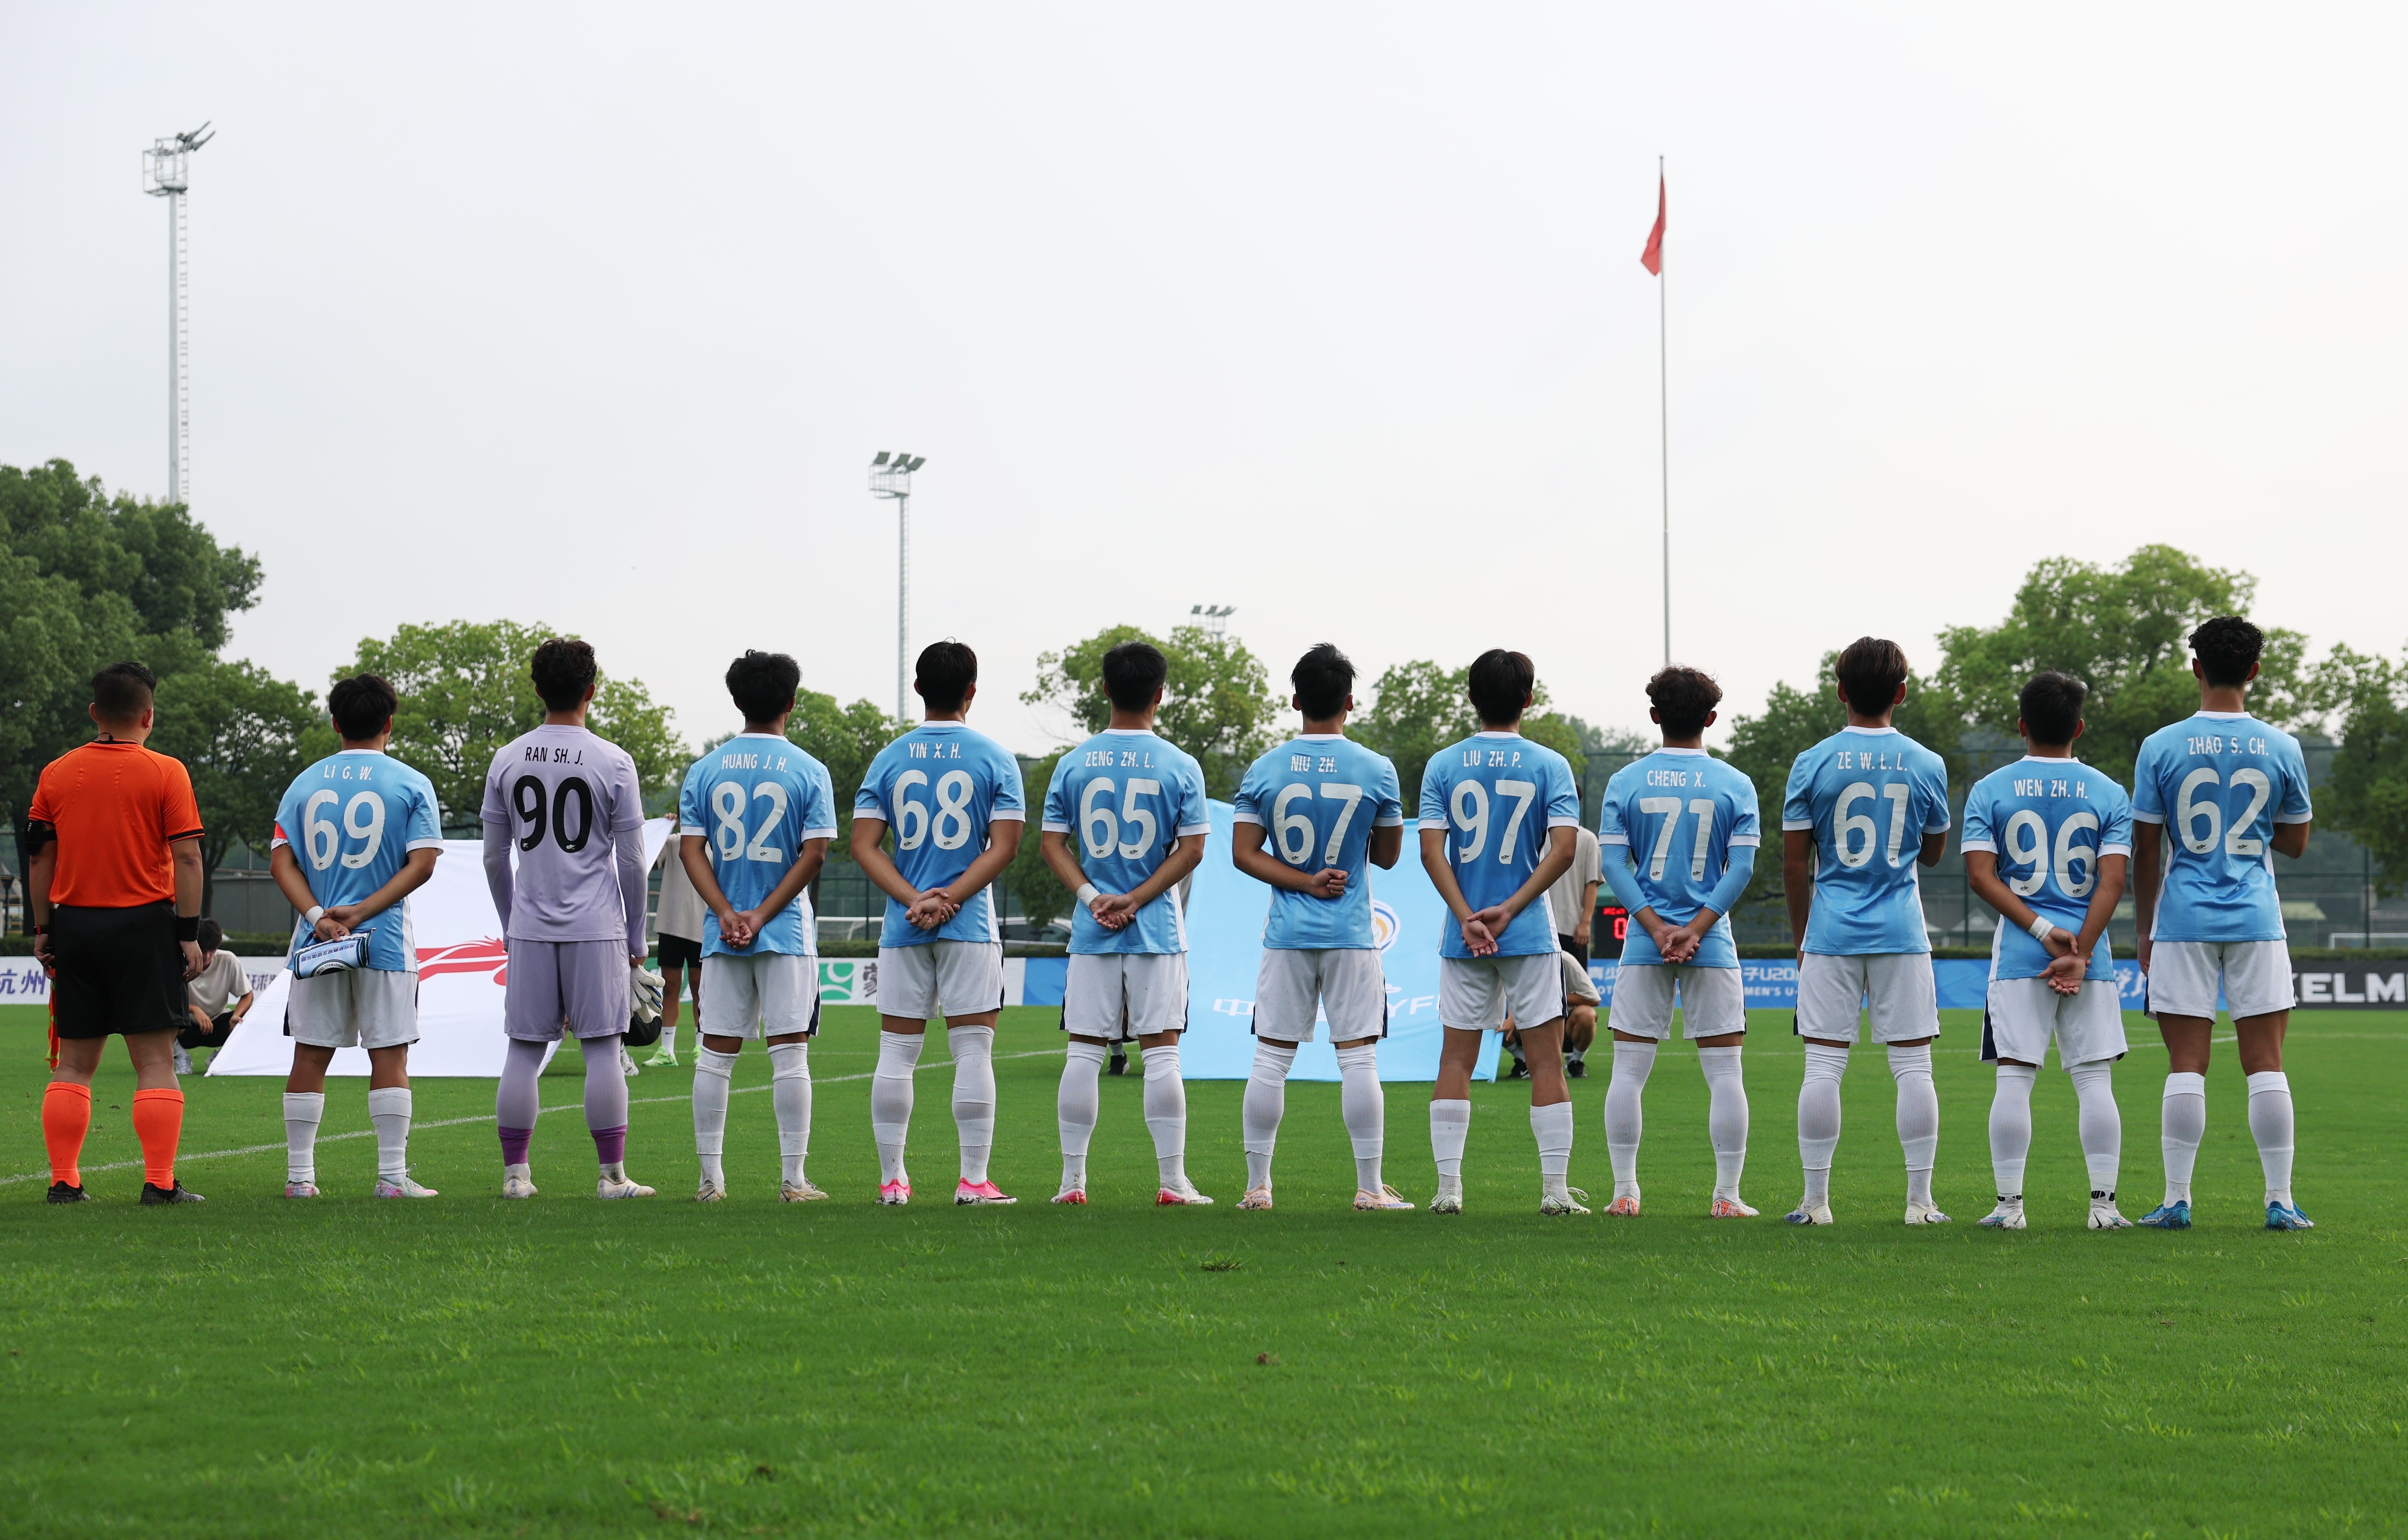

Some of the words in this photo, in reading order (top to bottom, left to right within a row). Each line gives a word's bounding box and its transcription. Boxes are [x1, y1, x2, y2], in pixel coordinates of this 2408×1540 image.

[525, 746, 548, 762] RAN
[553, 748, 570, 764] SH.
[574, 750, 583, 766] J.
[909, 743, 928, 759] YIN
[933, 743, 945, 758] X.
[950, 743, 961, 759] H.
[2187, 736, 2222, 756] ZHAO
[2231, 737, 2243, 753] S.
[2249, 737, 2269, 756] CH.
[722, 753, 758, 770] HUANG
[763, 754, 772, 770] J.
[777, 757, 787, 773] H.
[1085, 750, 1114, 767] ZENG
[1120, 751, 1139, 767] ZH.
[1144, 752, 1154, 768] L.
[1291, 755, 1310, 772] NIU
[1318, 756, 1337, 773] ZH.
[1463, 750, 1481, 767] LIU
[1488, 751, 1507, 767] ZH.
[1511, 751, 1521, 768] P.
[1838, 751, 1852, 770] ZE
[1860, 752, 1875, 770] W.
[1880, 753, 1892, 770] L.
[1896, 753, 1908, 771] L.
[324, 765, 336, 778] LI
[343, 766, 353, 779] G.
[359, 766, 373, 780] W.
[1647, 770, 1686, 787] CHENG
[1694, 772, 1706, 787] X.
[2014, 779, 2043, 797] WEN
[2050, 779, 2071, 798] ZH.
[2076, 781, 2088, 800] H.
[513, 775, 593, 853] 90
[893, 769, 974, 850] 68
[1080, 777, 1160, 859] 65
[2177, 767, 2270, 855] 62
[304, 789, 386, 870] 69
[712, 781, 787, 863] 82
[1273, 783, 1362, 865] 67
[1450, 779, 1536, 865] 97
[1833, 782, 1909, 867] 61
[1640, 796, 1715, 882] 71
[2005, 809, 2099, 898] 96
[1588, 966, 1618, 980] 青少
[1742, 967, 1799, 981] 子U20
[2292, 973, 2408, 1003] ELM
